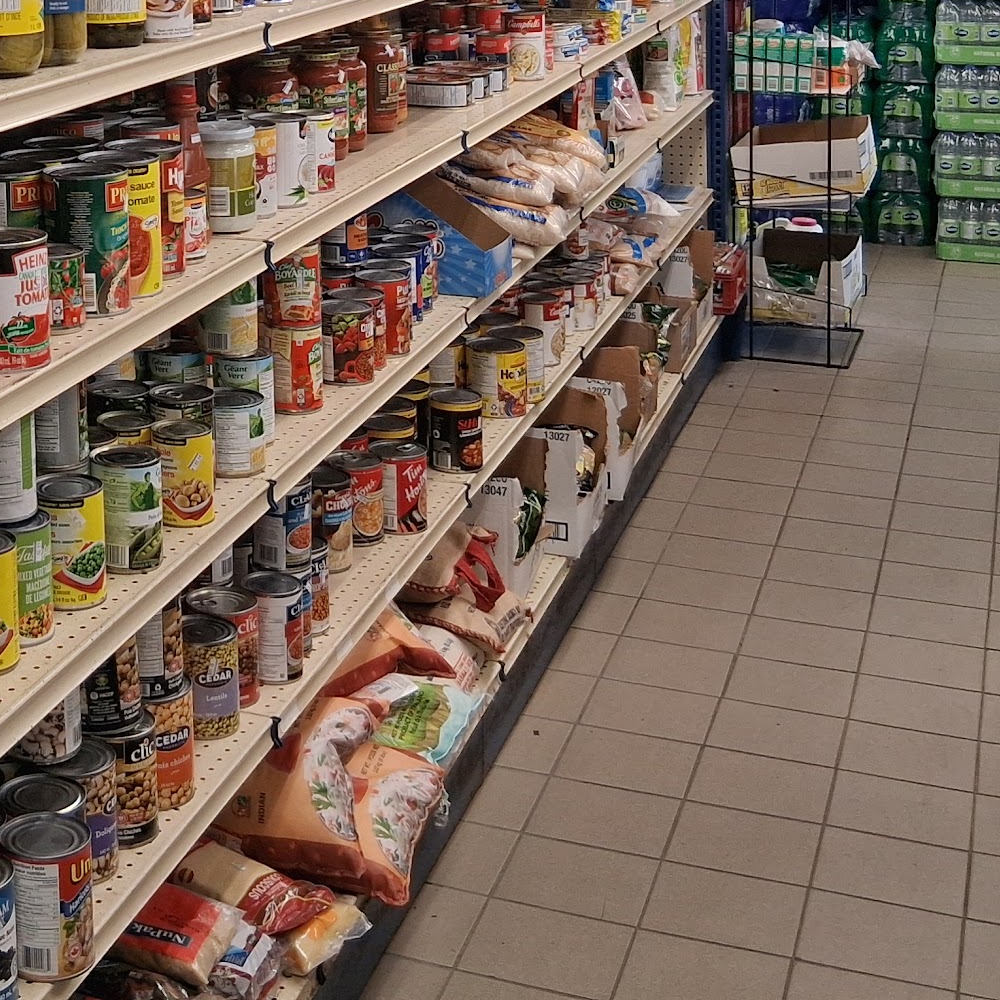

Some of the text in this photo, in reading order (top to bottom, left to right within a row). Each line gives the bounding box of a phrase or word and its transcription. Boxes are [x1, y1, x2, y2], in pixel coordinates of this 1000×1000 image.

[130, 181, 156, 192] sauce
[127, 195, 156, 207] omate
[223, 363, 248, 373] Géant
[228, 372, 244, 380] Vert
[544, 430, 571, 442] 13027
[198, 668, 232, 685] CEDAR
[206, 691, 228, 702] Lentils
[155, 729, 190, 748] CEDAR
[156, 761, 169, 770] ois
[258, 791, 266, 825] INDIAN
[130, 922, 188, 945] NuPak
